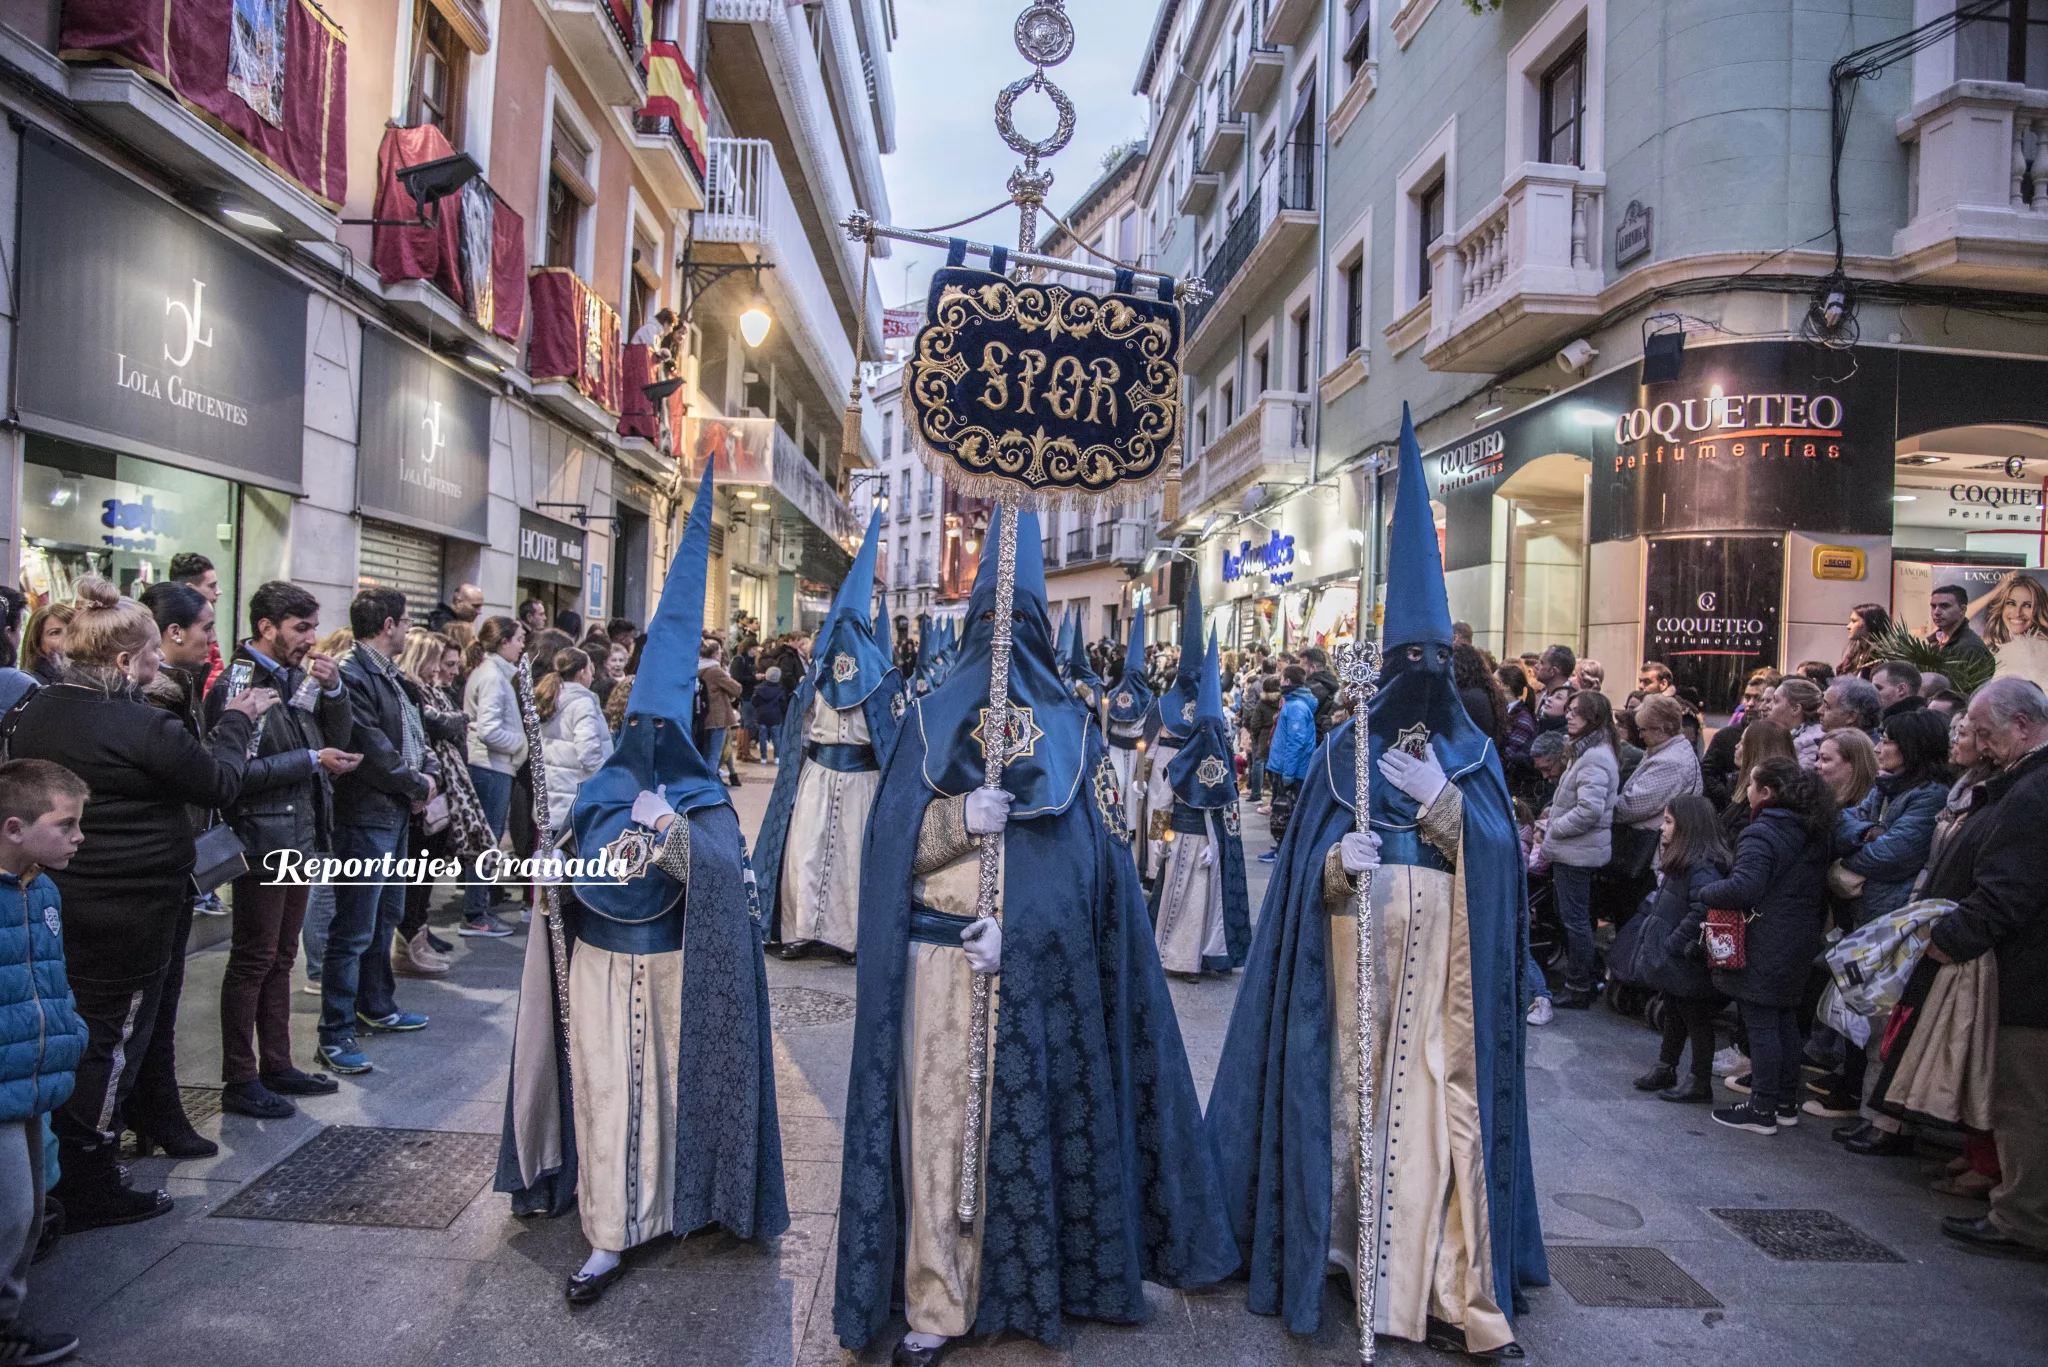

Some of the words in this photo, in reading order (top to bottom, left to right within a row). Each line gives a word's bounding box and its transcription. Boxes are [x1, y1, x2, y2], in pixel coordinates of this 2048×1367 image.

[117, 353, 162, 399] LOLA
[168, 375, 248, 427] CIFUENTES
[976, 341, 1121, 427] SPQR
[1614, 394, 1843, 445] COQUETEO
[1440, 430, 1504, 475] COQUETEO
[520, 528, 559, 565] HOTEL
[1656, 617, 1763, 635] COQUETEO
